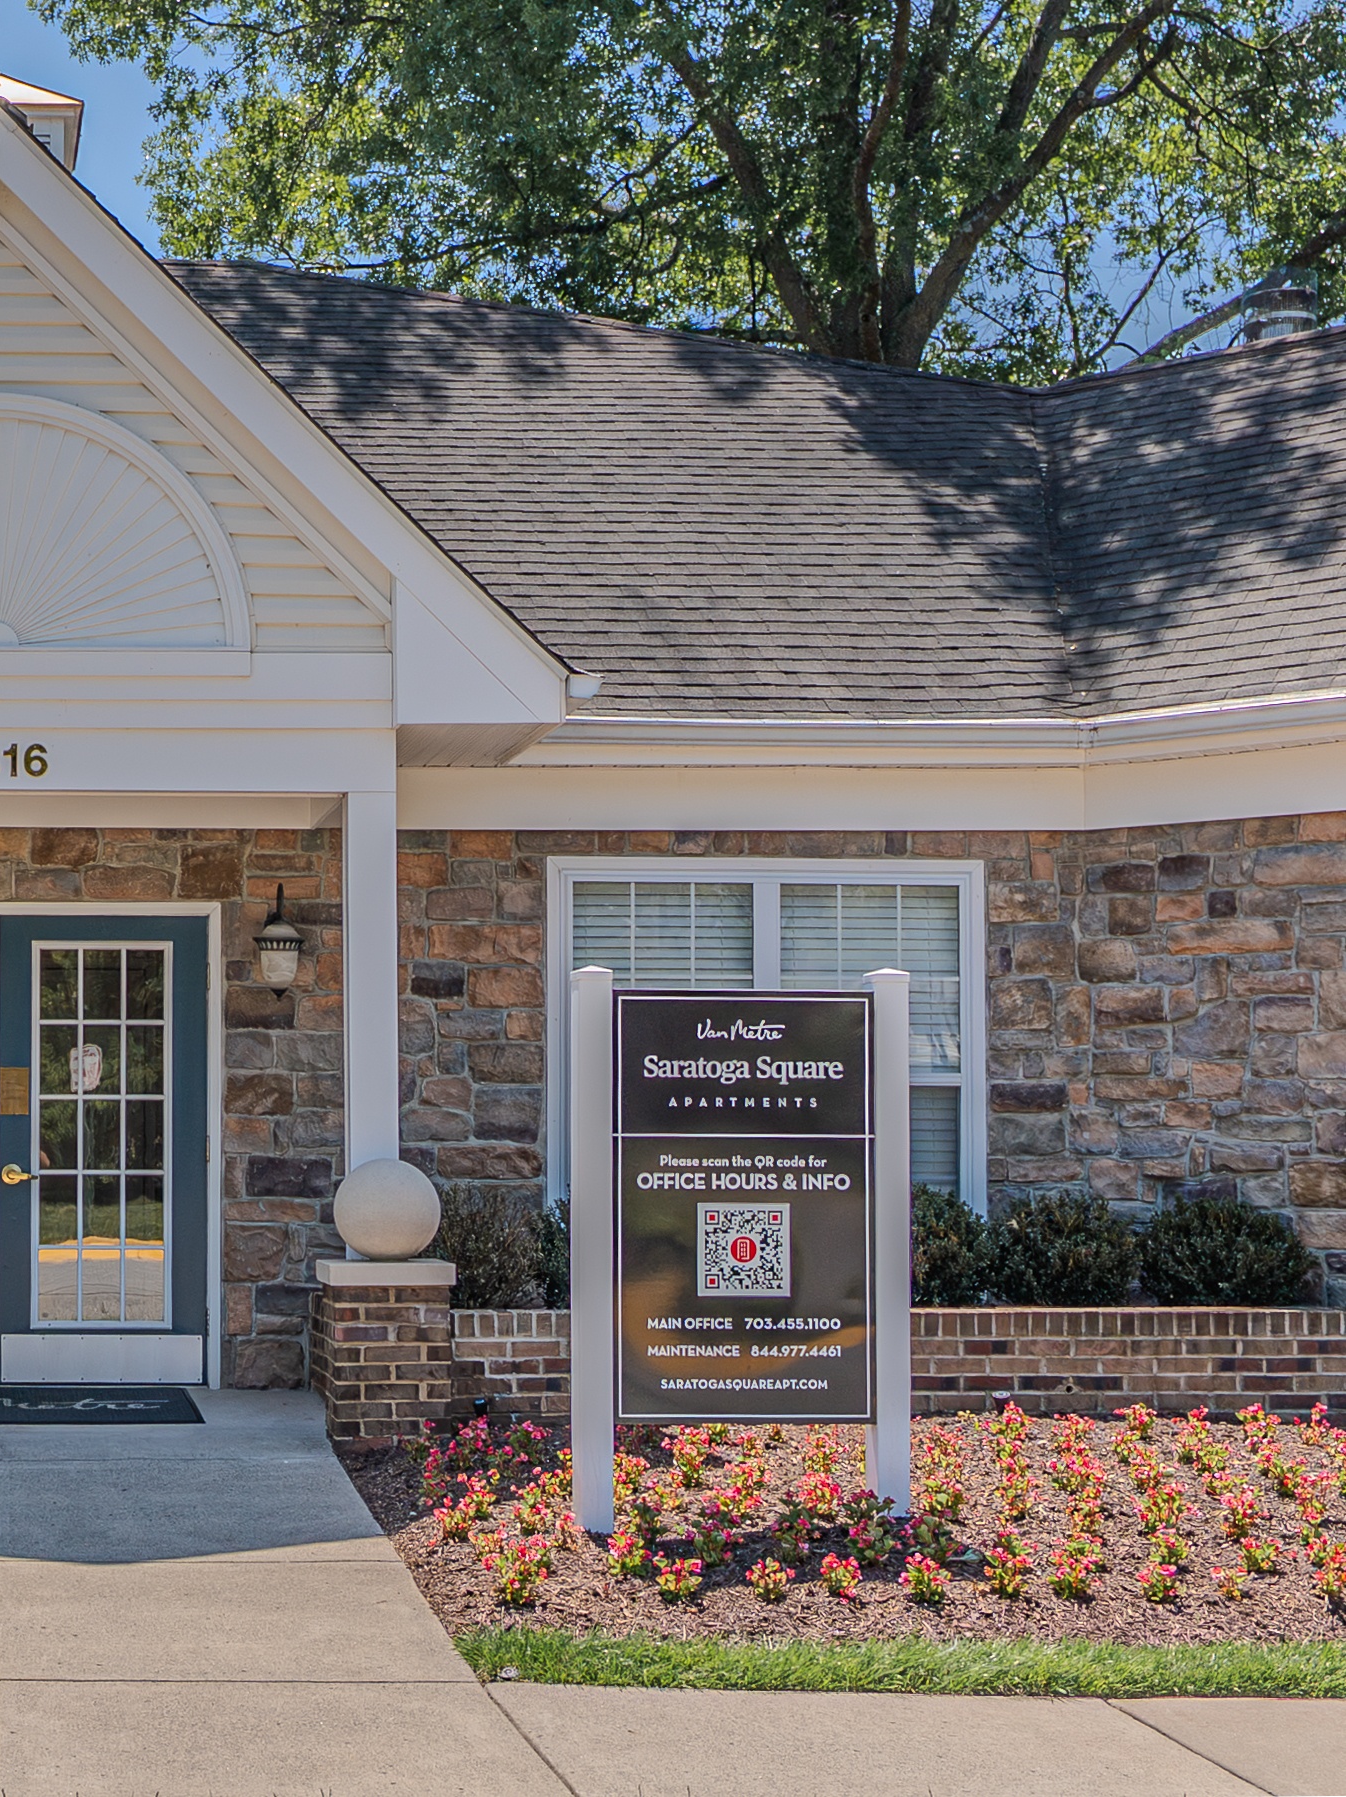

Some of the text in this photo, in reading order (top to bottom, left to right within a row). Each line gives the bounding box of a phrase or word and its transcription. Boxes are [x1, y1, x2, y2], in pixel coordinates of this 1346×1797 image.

[697, 1018, 786, 1041] Van Metre
[643, 1055, 844, 1085] Saratoga Square
[668, 1096, 819, 1108] APARTMENTS
[659, 1154, 828, 1169] Please scan the QR code for
[636, 1172, 851, 1190] OFFICE HOURS & INFO
[647, 1318, 841, 1330] MAIN OFFICE 703.455.1100
[647, 1345, 842, 1357] MAINTENANCE 844.977.4461
[660, 1379, 828, 1391] SARATOGASQUAREAPT.COM
